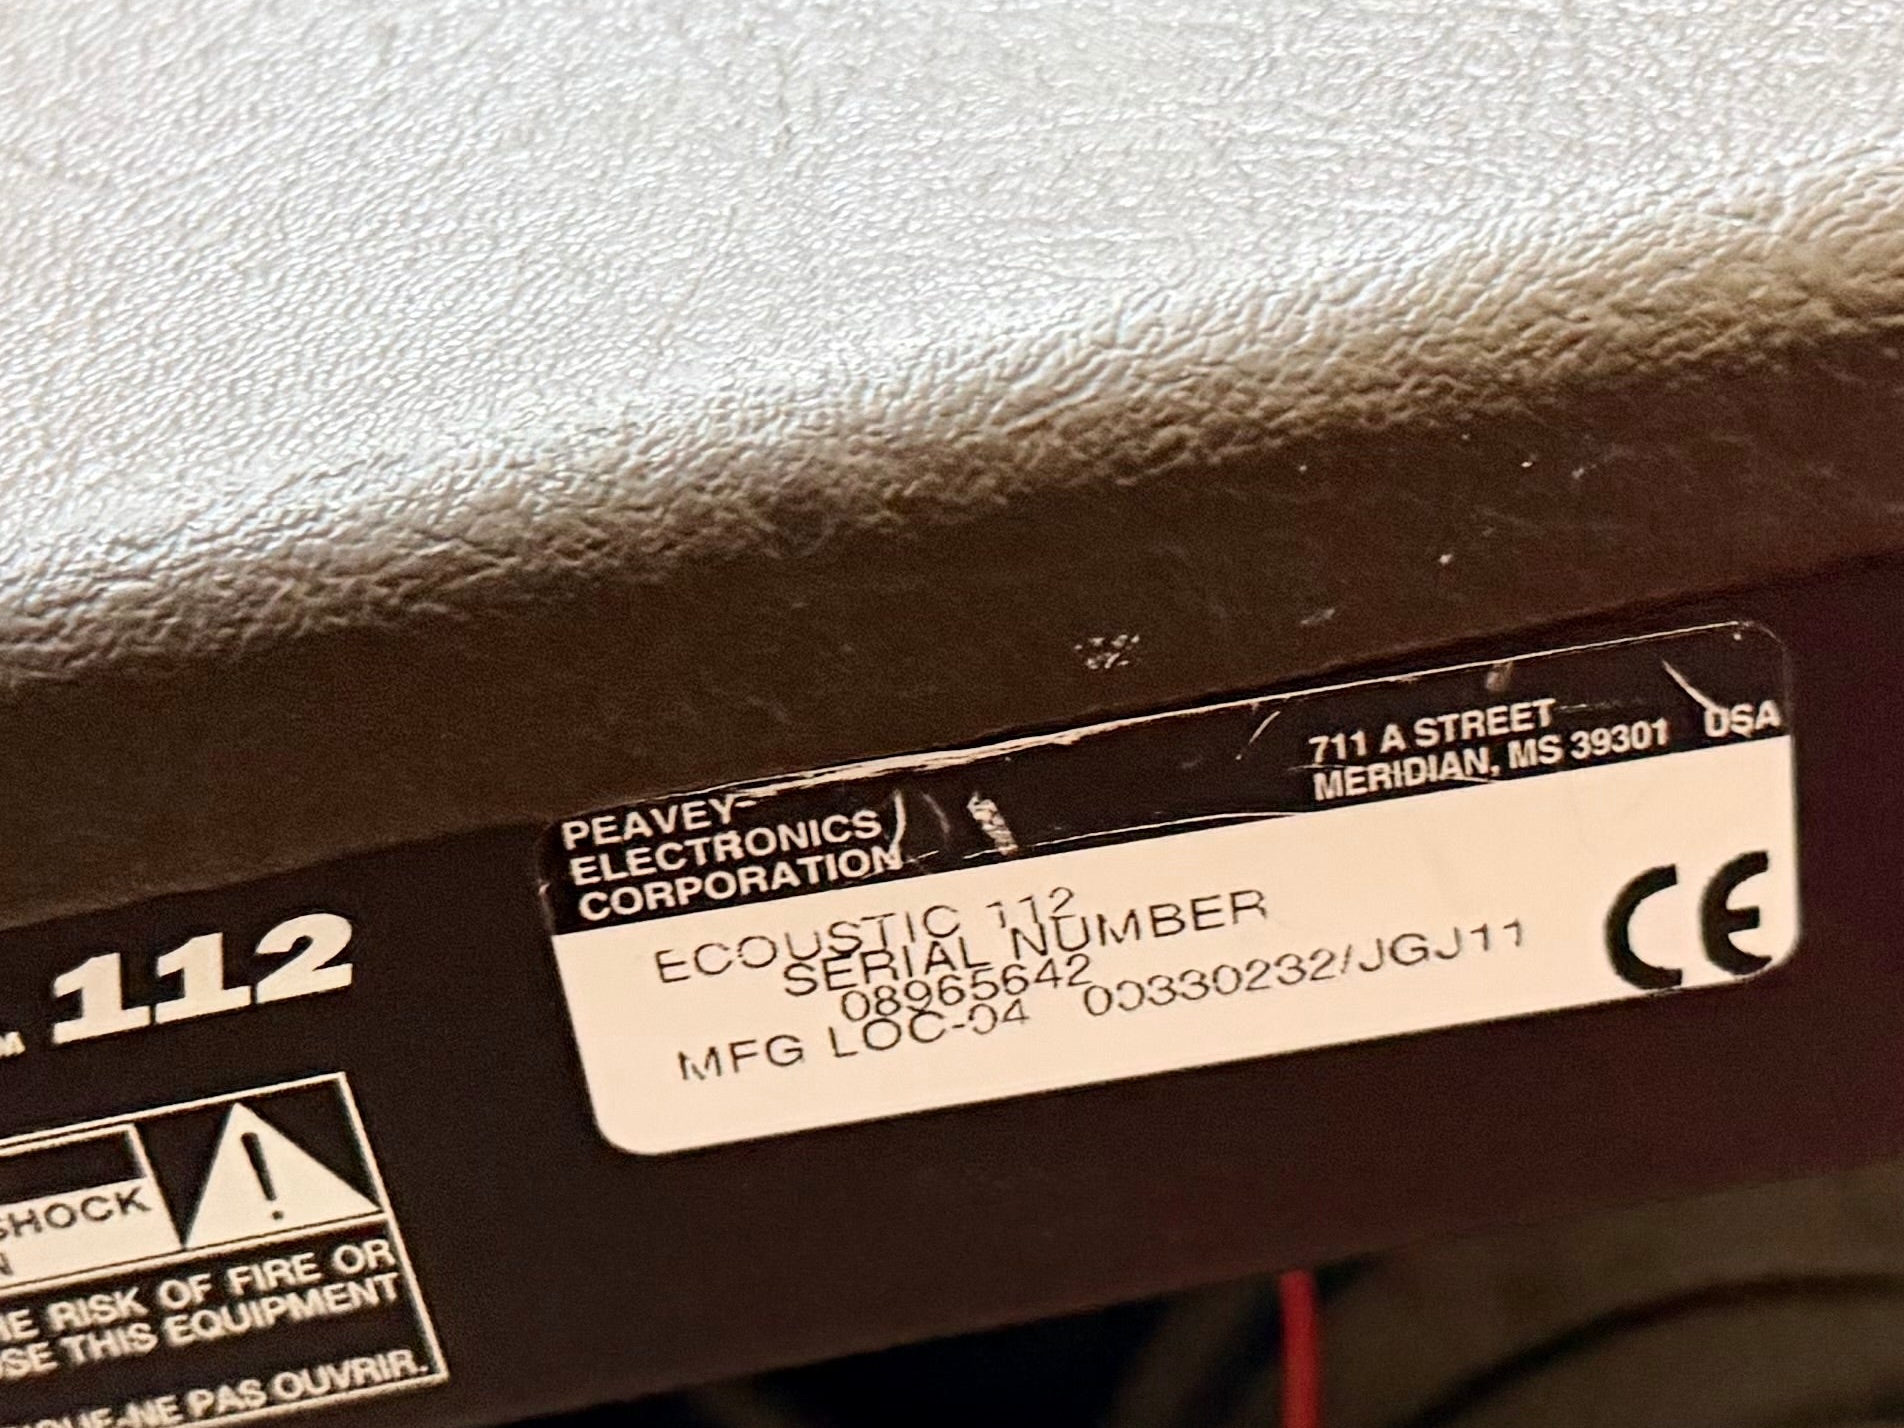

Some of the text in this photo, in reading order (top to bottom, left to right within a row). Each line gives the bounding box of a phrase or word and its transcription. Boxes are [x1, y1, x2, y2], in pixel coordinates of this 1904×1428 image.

[1308, 697, 1556, 764] 711 A STREET
[1313, 699, 1783, 803] MERIDIAN, MS 39301 USA
[562, 792, 738, 851] PEAVEY
[569, 809, 882, 887] ELECTRONICS
[579, 846, 904, 921] CORPORATION
[1604, 849, 1774, 990] CE
[51, 912, 356, 1048] 112
[655, 885, 1076, 984] ECOUSTIC 112
[783, 888, 1269, 997] SERIAL NUMBER
[678, 918, 1528, 1082] MFG LOC-04 00330232/JGJ11
[840, 953, 1095, 1022] 08965642
[47, 1291, 145, 1333] RISK
[156, 1271, 213, 1310] OF
[226, 1252, 322, 1296] FIRE
[331, 1237, 397, 1273] OR
[61, 1322, 160, 1368] THIS
[162, 1272, 401, 1348] EQUIPMENT
[185, 1374, 268, 1422] PAS
[270, 1347, 431, 1402] OUVRIR.
